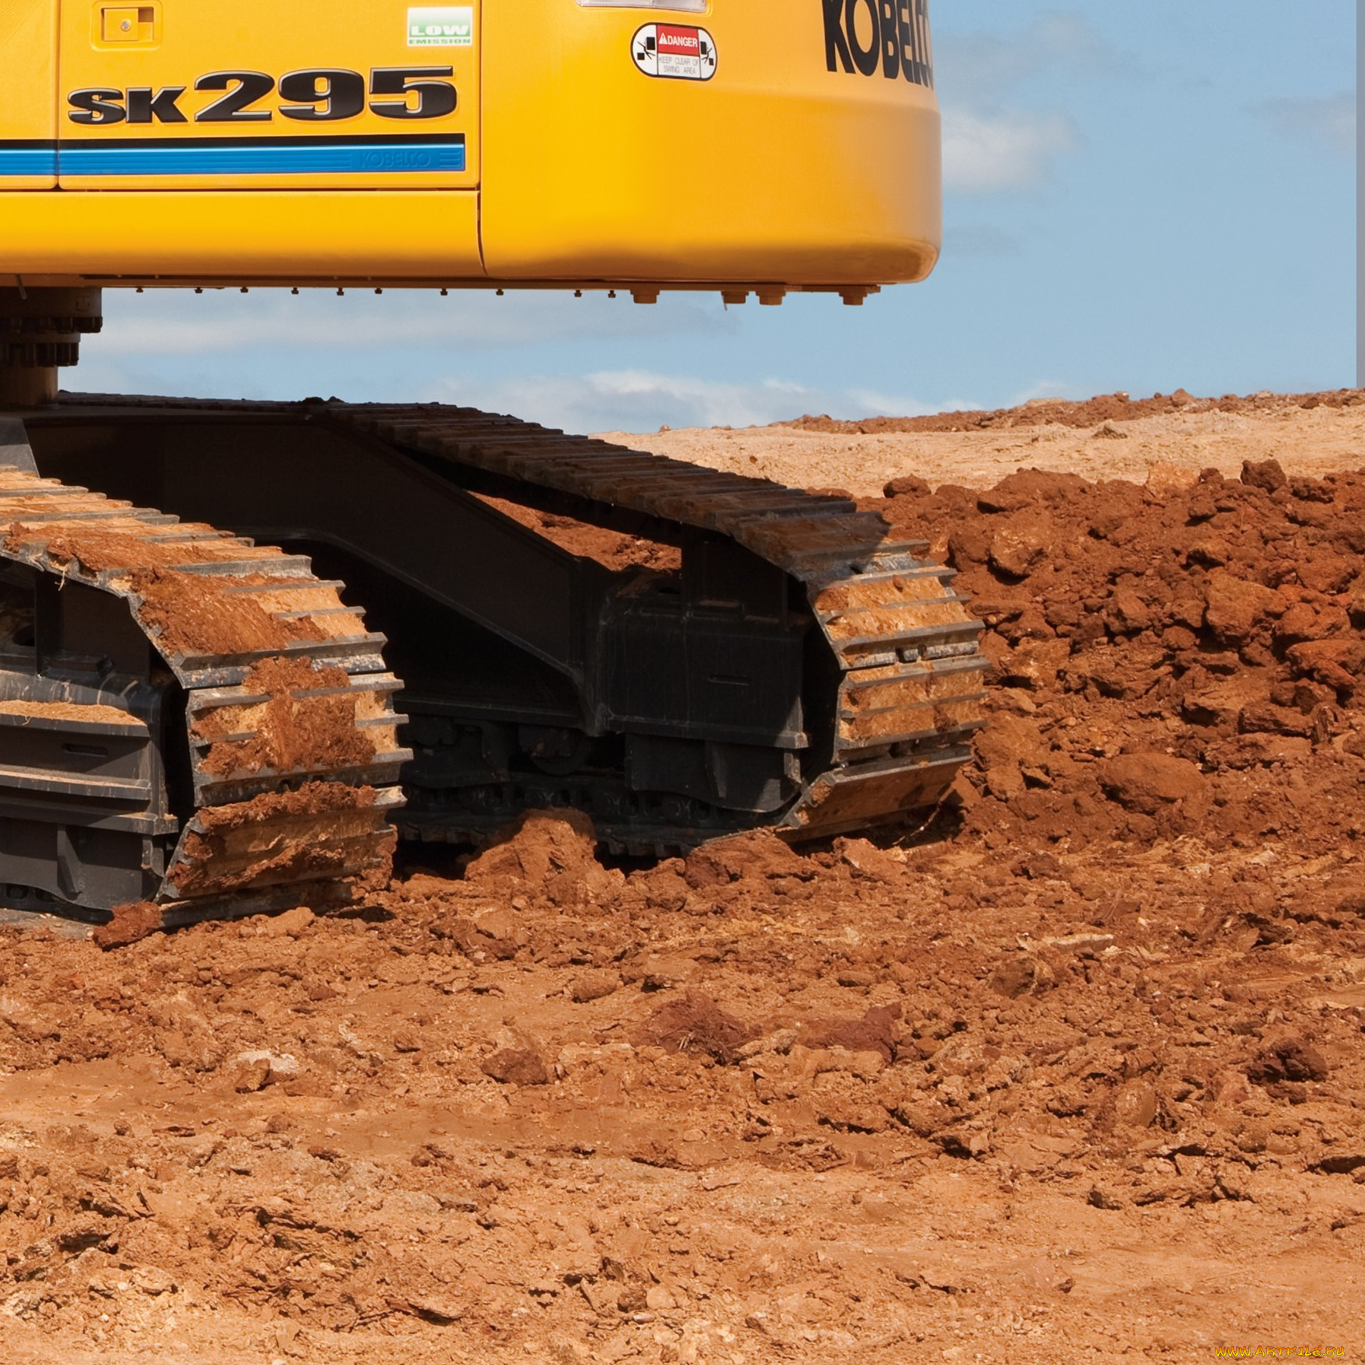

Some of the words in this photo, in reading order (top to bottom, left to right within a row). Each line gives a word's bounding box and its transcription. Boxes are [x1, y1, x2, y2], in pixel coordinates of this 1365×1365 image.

[411, 25, 470, 36] LOW
[667, 35, 698, 48] DANGER
[659, 56, 673, 65] KEEP
[674, 57, 691, 66] CLEAR
[663, 65, 680, 74] SWING
[683, 67, 696, 75] AREA
[67, 66, 458, 125] SK295
[360, 151, 431, 168] KOBELCO
